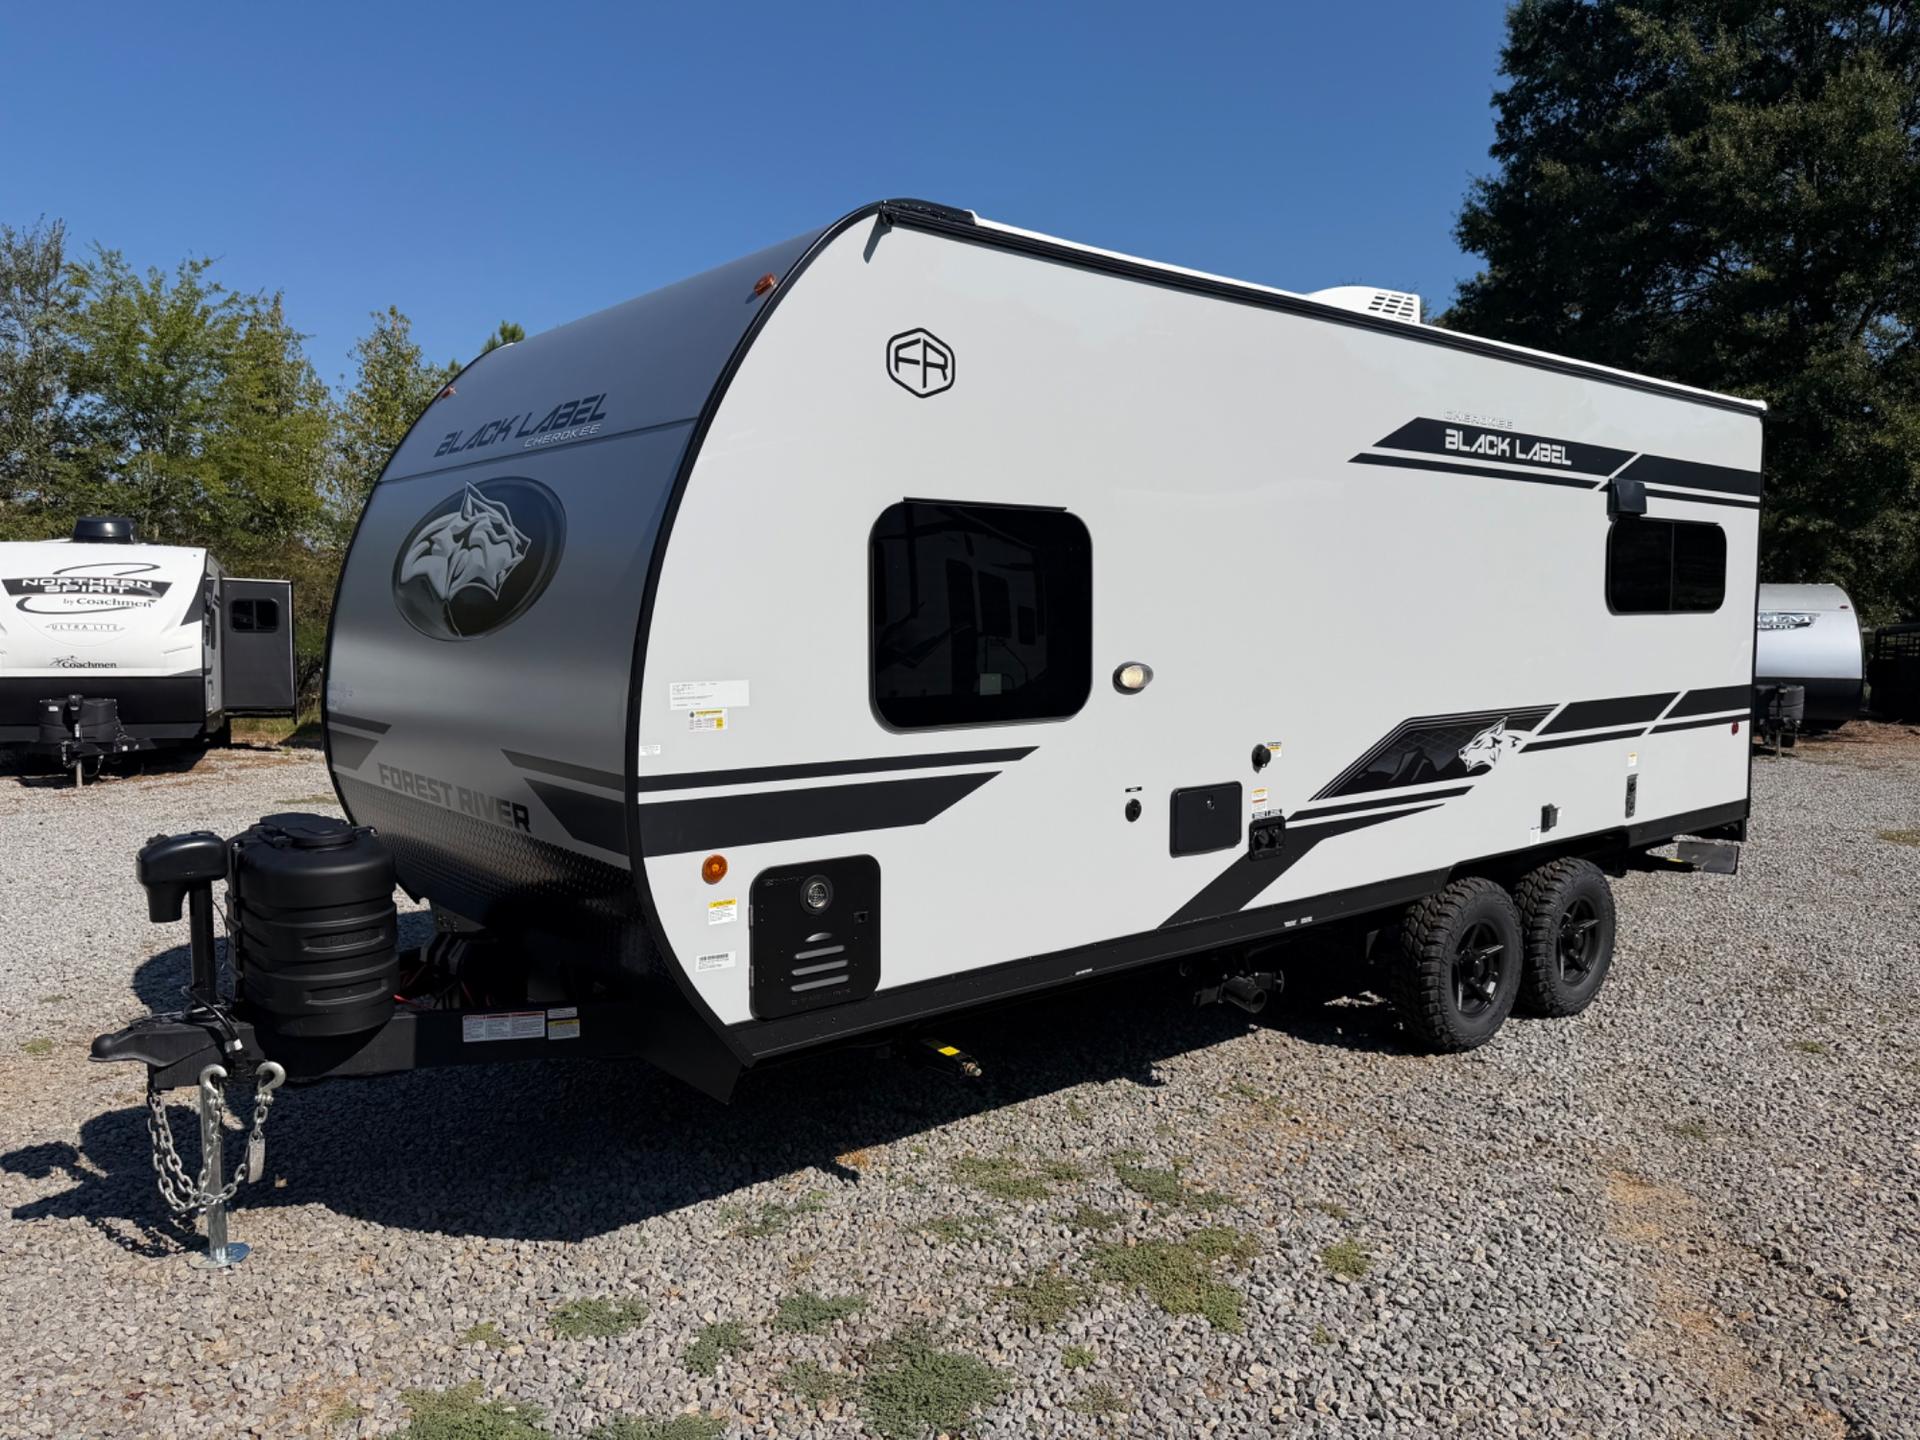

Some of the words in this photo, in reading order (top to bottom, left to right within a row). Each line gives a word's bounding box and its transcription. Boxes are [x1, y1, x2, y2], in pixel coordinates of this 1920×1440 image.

[433, 414, 521, 458] BLACK
[514, 392, 608, 439] LABEL
[1444, 409, 1514, 430] CHEROKEE
[523, 422, 602, 449] CHEROKEE
[1445, 429, 1510, 457] BLACK
[1515, 440, 1572, 466] LABEL
[22, 578, 152, 588] NORTHERN
[44, 585, 129, 594] SPIRIT
[62, 597, 75, 606] by
[76, 596, 152, 609] Coachmen
[51, 623, 89, 632] ULTRA
[93, 623, 119, 632] LITE
[62, 660, 117, 669] Coachmen
[377, 761, 453, 807] FOREST
[456, 785, 532, 834] RIVER
